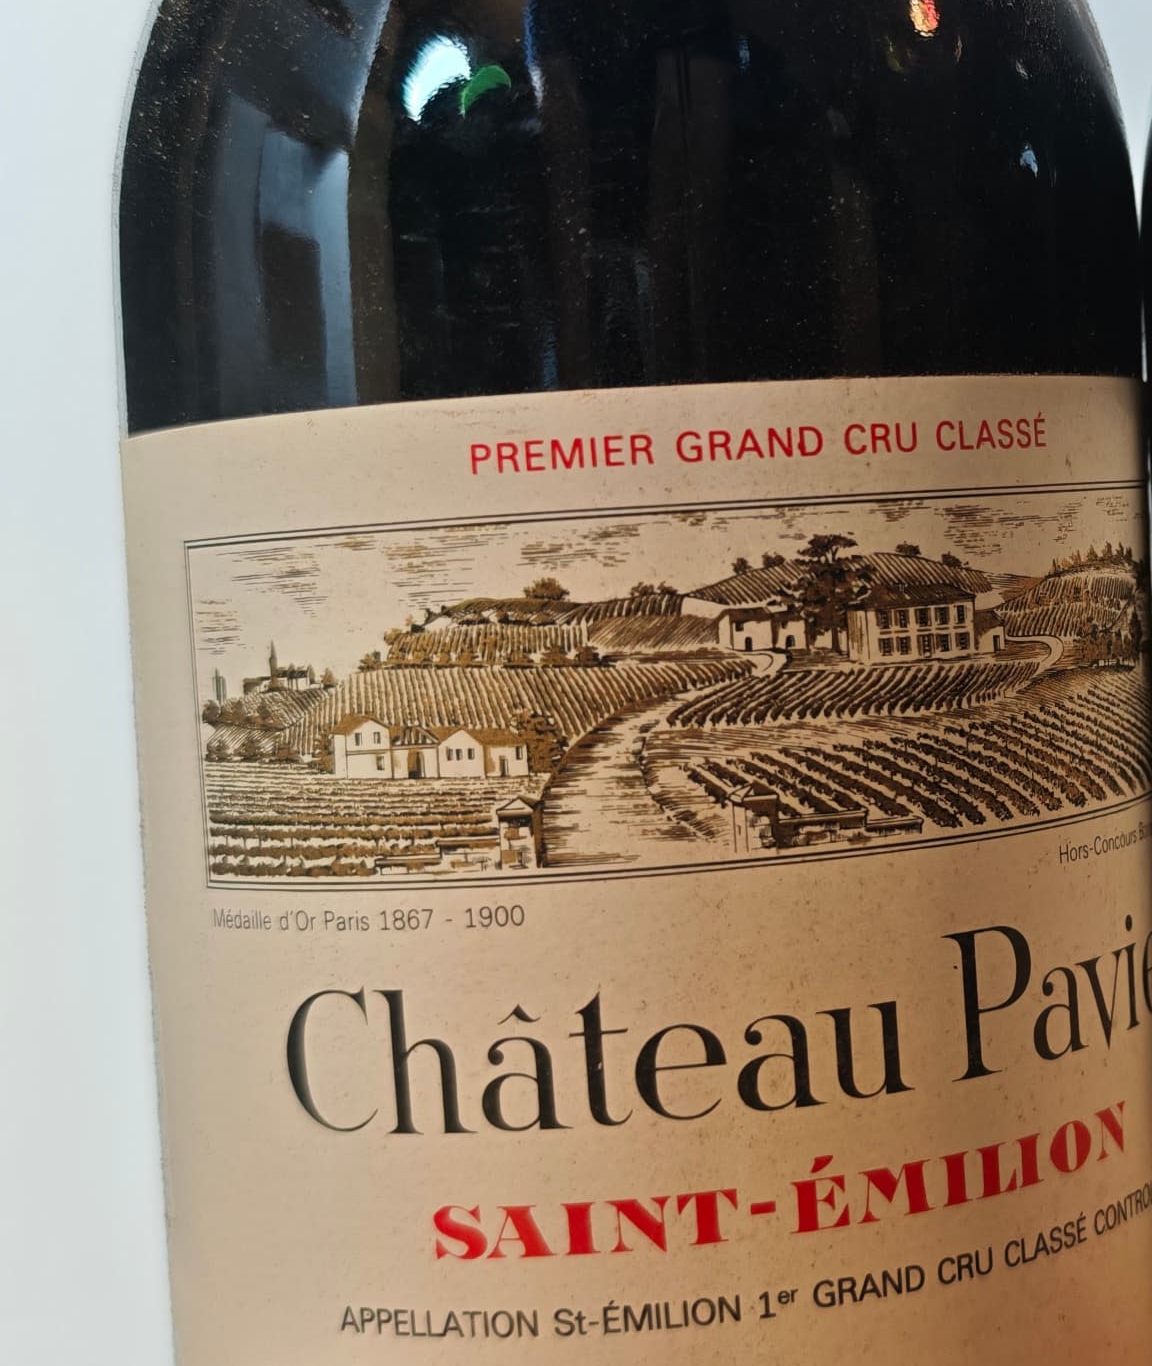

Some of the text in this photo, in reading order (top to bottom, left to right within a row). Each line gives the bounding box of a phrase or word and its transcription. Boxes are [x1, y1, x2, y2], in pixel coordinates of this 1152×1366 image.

[469, 411, 1048, 475] PREMIER GRAND CRU CLASSÉ
[1058, 828, 1138, 864] Hors-Concours
[213, 906, 272, 931] Médaille
[279, 909, 314, 933] d'Or
[324, 912, 370, 932] Paris
[379, 908, 434, 931] 1867
[464, 904, 526, 929] 1900
[286, 985, 915, 1135] Château
[432, 1101, 1126, 1261] SAINT-ÉMILION
[341, 1305, 539, 1338] APPELLATION
[554, 1294, 742, 1336] St-ÉMILION
[758, 1288, 799, 1320] 1er
[812, 1264, 926, 1309] GRAND
[937, 1247, 994, 1285] CRU
[1004, 1211, 1087, 1268] CLASSÉ
